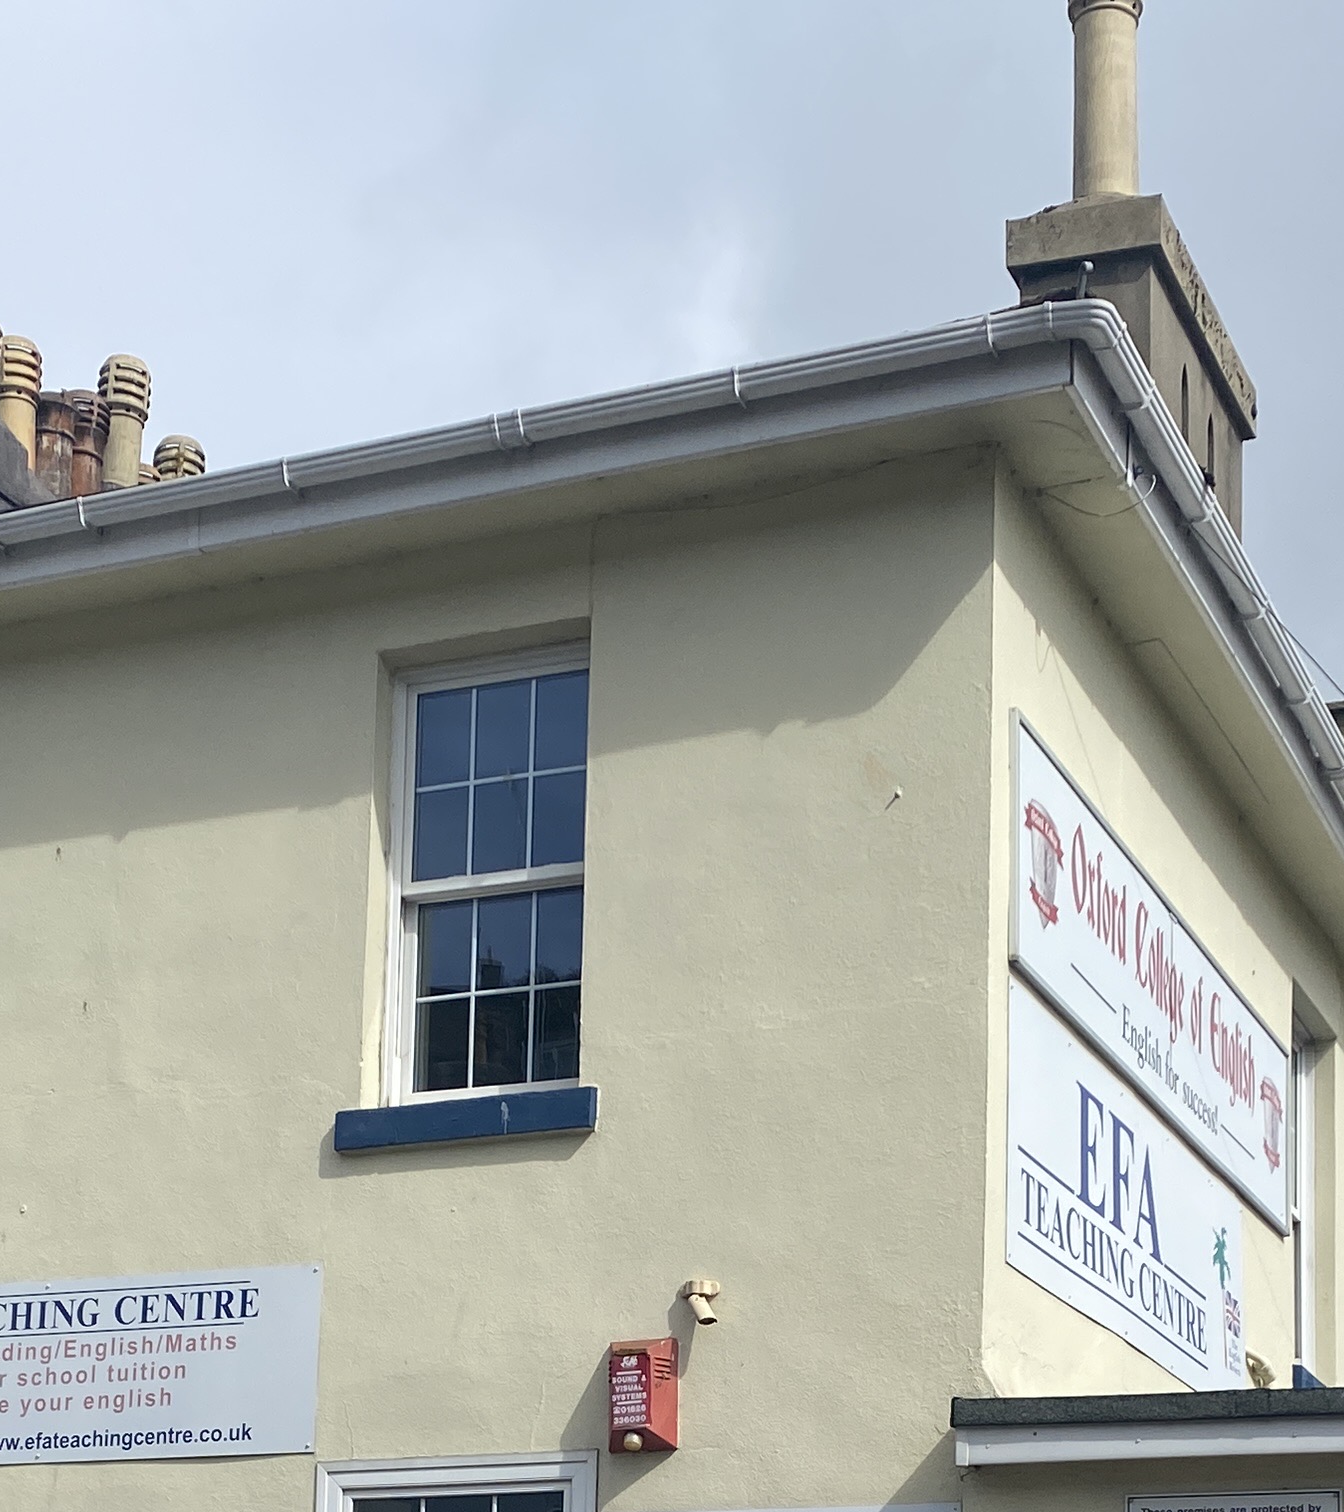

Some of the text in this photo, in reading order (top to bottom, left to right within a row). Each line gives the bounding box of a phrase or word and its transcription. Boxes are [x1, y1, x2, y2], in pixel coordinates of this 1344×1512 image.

[1072, 822, 1256, 1117] Oxford College of English
[1122, 1003, 1219, 1136] English for success!
[1076, 1080, 1164, 1265] EFA
[1021, 1167, 1207, 1355] TEACHING CENTRE
[114, 1288, 260, 1325] CENTRE
[16, 1364, 96, 1387] school
[107, 1362, 186, 1382] tuition
[612, 1376, 638, 1384] SOUND
[615, 1384, 644, 1393] VISUAL
[20, 1396, 73, 1417] your
[84, 1387, 172, 1414] english
[612, 1392, 647, 1402] SYSTEMS
